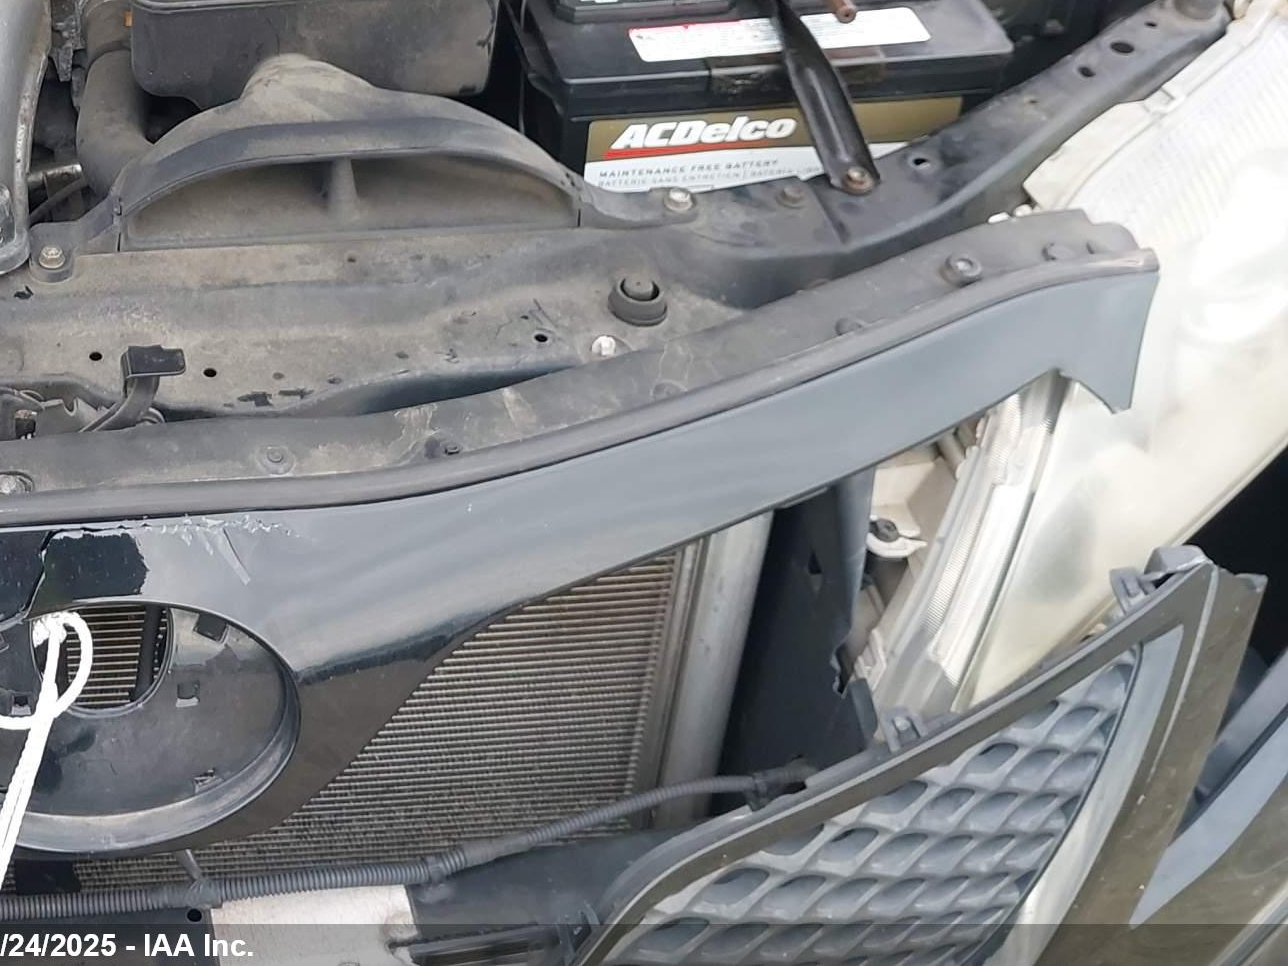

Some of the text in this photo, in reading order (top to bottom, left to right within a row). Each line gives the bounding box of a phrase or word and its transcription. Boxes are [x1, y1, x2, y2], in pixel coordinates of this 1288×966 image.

[611, 116, 797, 150] ACDelco
[599, 160, 778, 177] MAINTENANCE FREE BATTERY
